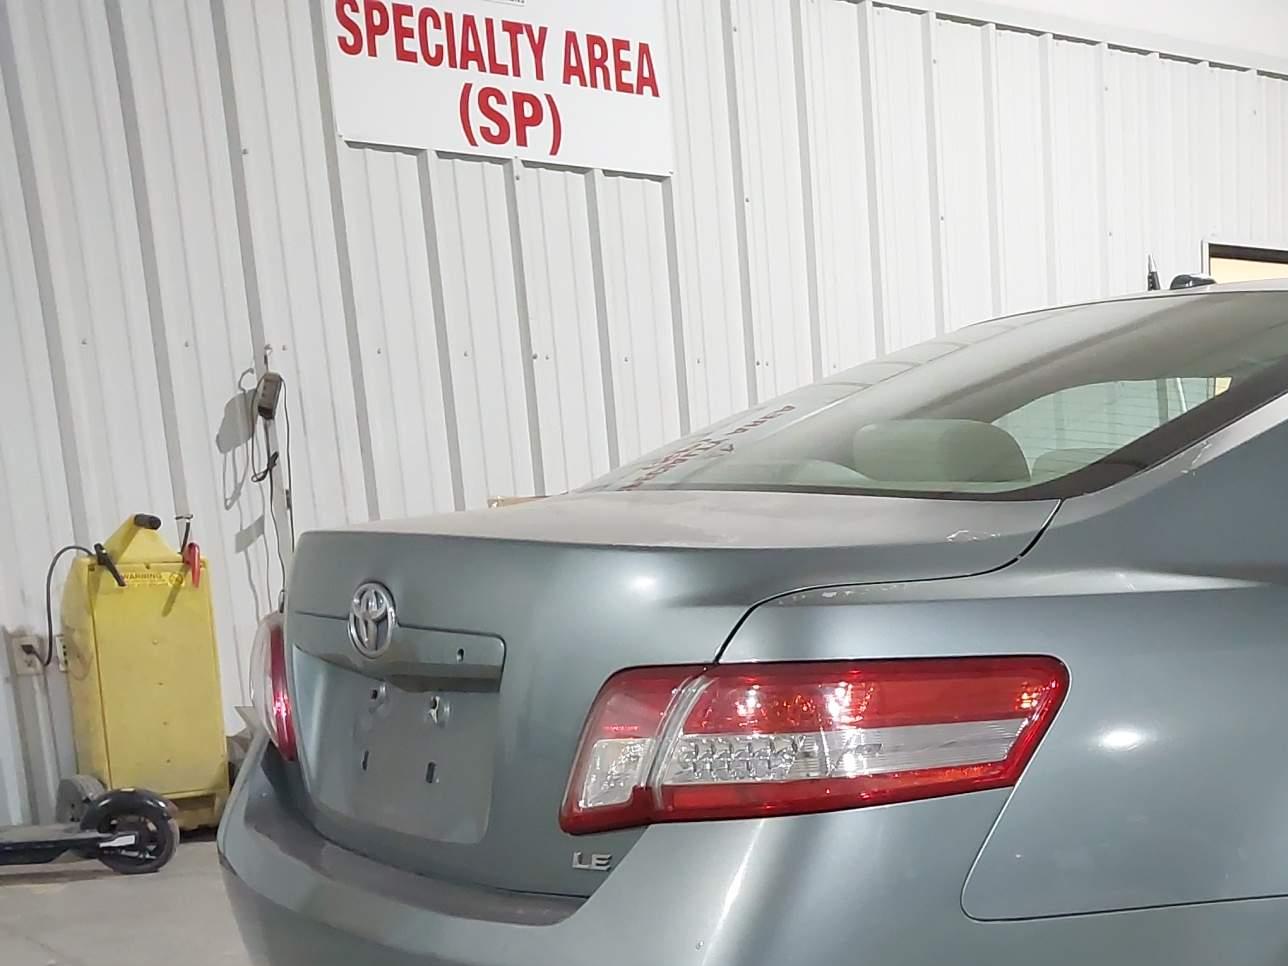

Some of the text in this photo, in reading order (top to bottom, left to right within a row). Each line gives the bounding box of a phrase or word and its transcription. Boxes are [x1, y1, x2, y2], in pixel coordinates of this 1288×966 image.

[335, 0, 660, 97] SPECIALTY AREA
[459, 83, 562, 155] (SP)
[572, 852, 611, 871] LE
